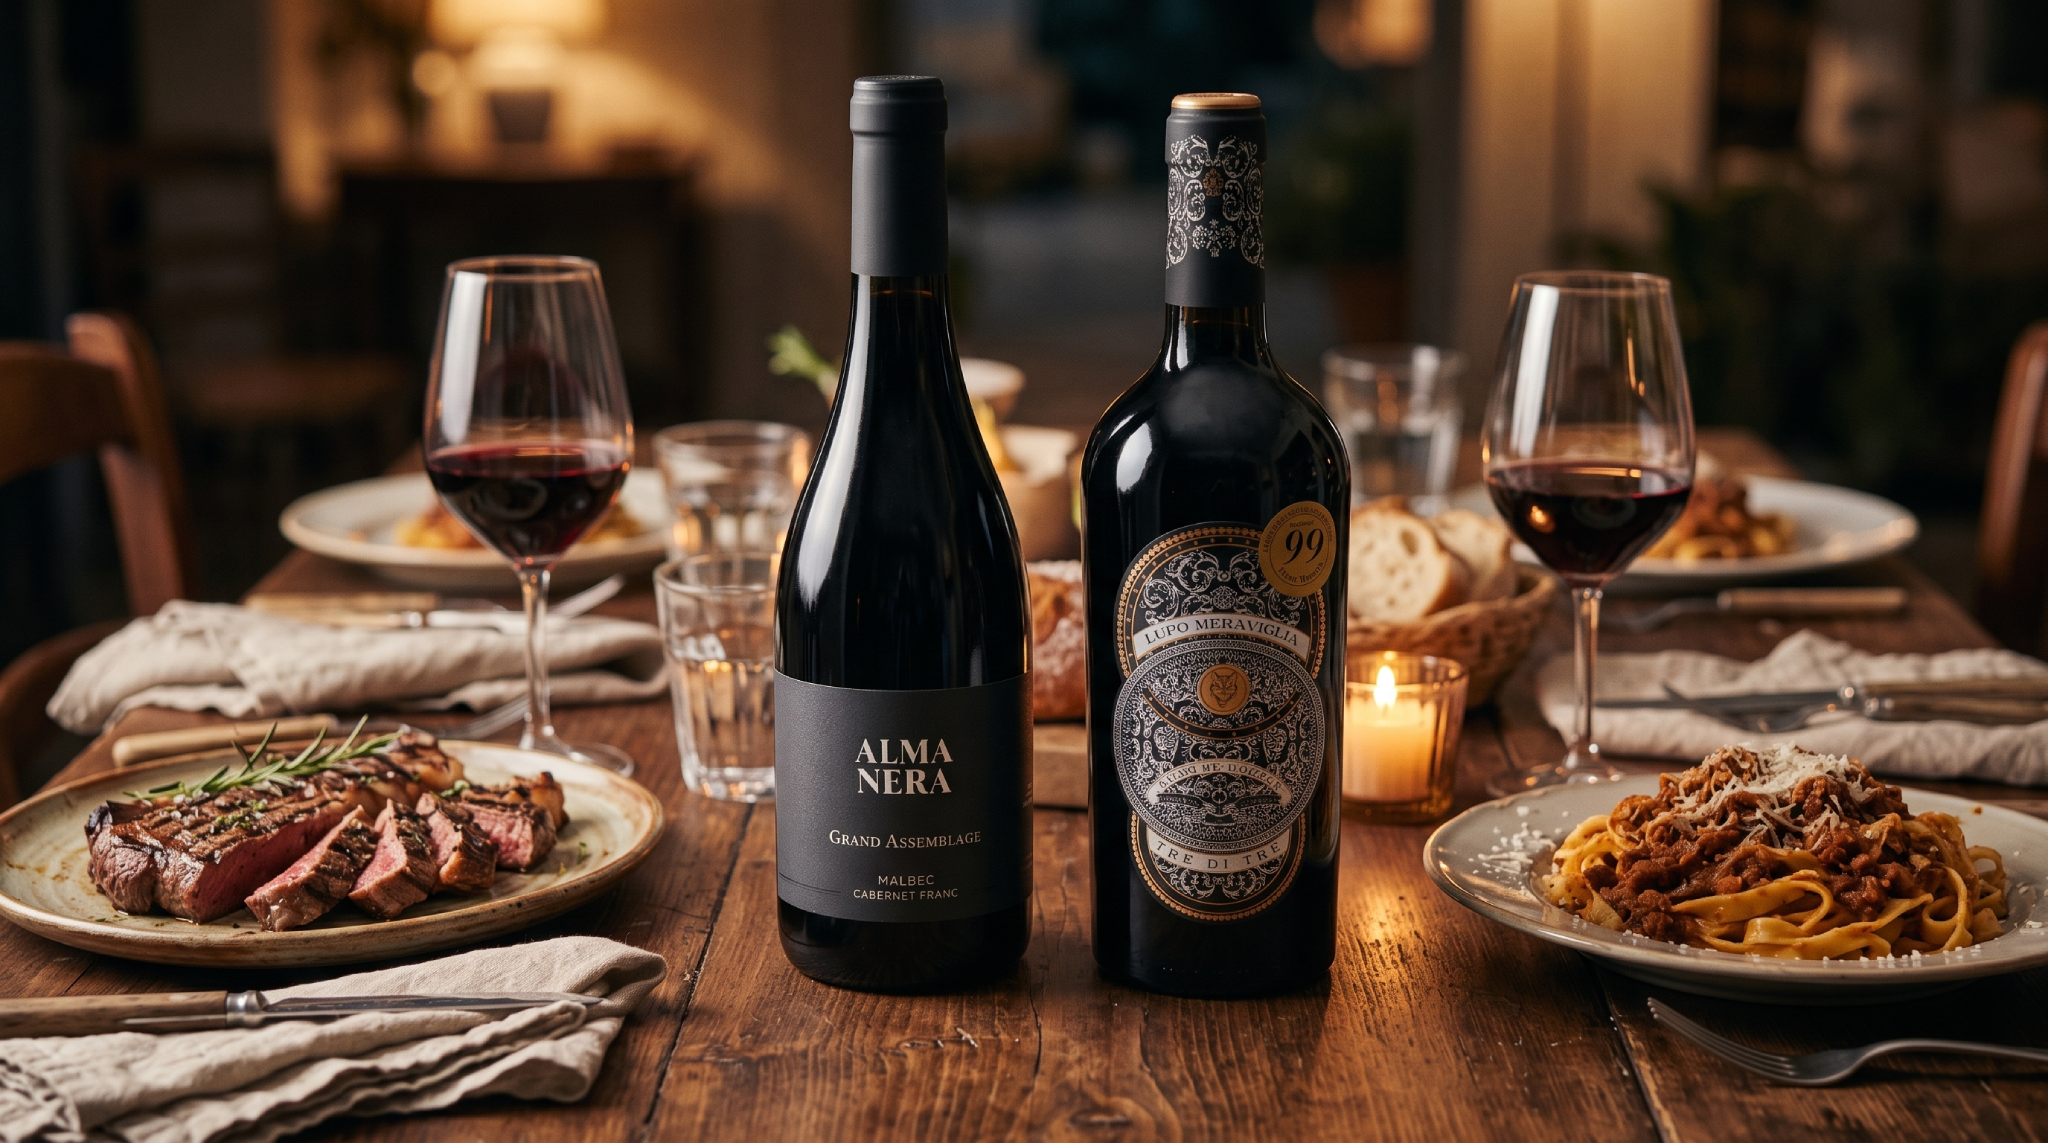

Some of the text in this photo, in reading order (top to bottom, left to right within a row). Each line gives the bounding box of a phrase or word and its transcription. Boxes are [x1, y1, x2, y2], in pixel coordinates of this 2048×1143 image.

[1282, 528, 1324, 565] 99
[1144, 618, 1299, 646] LUPO MERAVIGLIA
[855, 738, 953, 764] ALMA
[857, 768, 952, 795] NERA
[1157, 841, 1281, 869] TRE DI TRE
[853, 888, 959, 901] CABERNET FRANC
[878, 875, 935, 887] MALBEC
